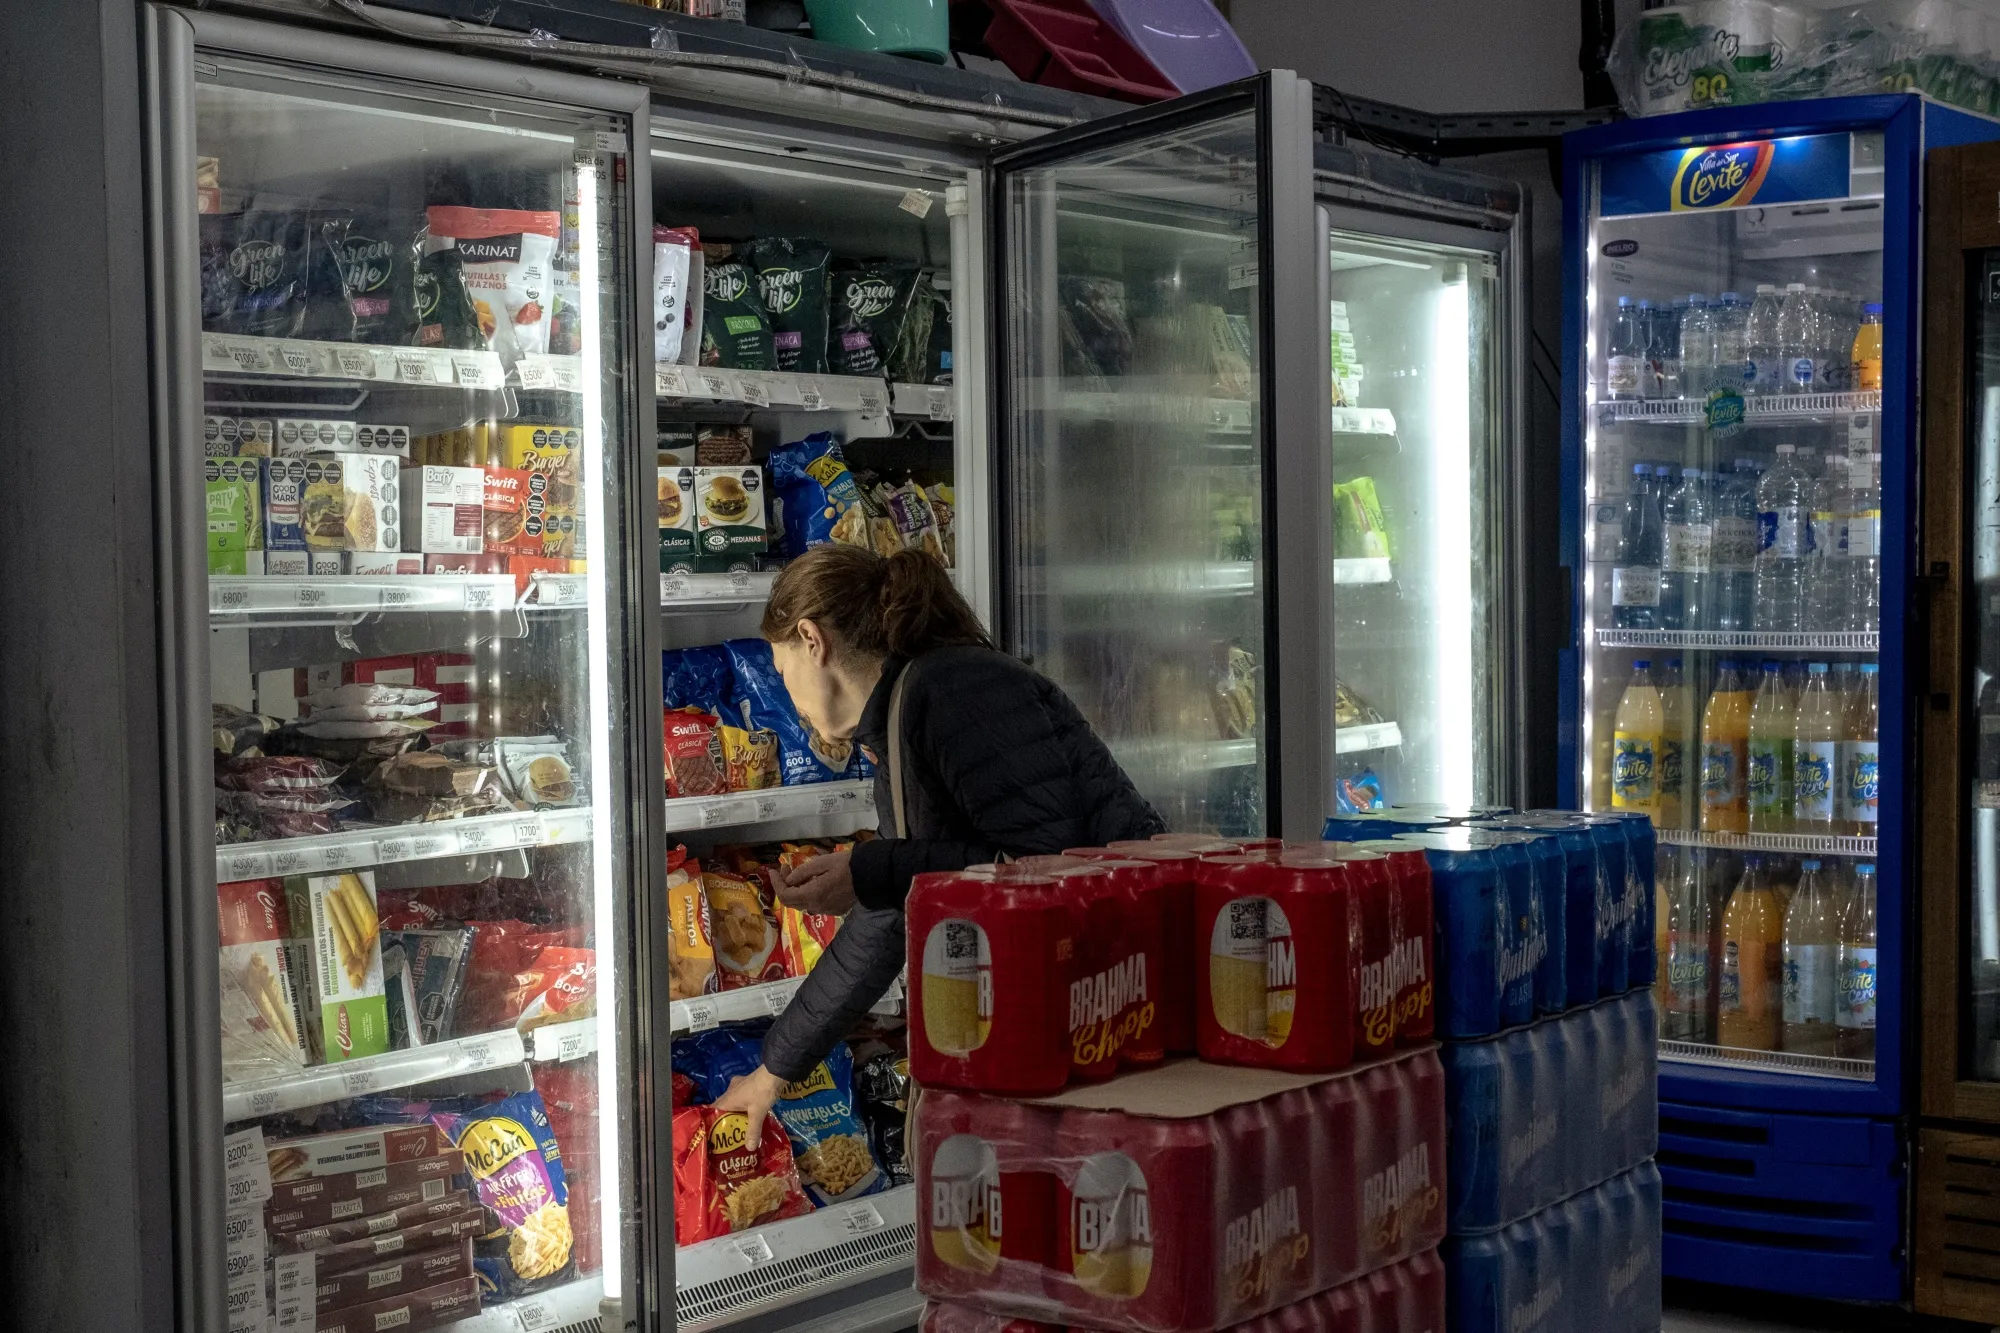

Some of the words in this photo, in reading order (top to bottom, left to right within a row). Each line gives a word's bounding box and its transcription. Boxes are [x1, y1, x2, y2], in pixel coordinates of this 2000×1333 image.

[593, 154, 605, 167] de
[1723, 151, 1740, 165] Sur
[457, 243, 518, 259] KARINAT
[234, 352, 254, 364] 4100
[288, 356, 305, 368] 6000
[343, 359, 361, 371] 8500
[205, 442, 230, 452] GOOD
[518, 449, 572, 478] Burger
[426, 468, 454, 486] Barfy
[483, 474, 519, 491] Swift
[272, 484, 297, 494] GOOD
[209, 492, 233, 505] PATY
[272, 494, 297, 502] MARK
[663, 537, 690, 547] CLÁSICAS
[729, 535, 762, 545] MEDIANAS
[315, 561, 339, 571] GOOD
[223, 592, 242, 604] 6800
[301, 590, 319, 601] 5500
[469, 590, 486, 602] 2900
[671, 723, 701, 737] Swift
[729, 745, 769, 769] Burger
[786, 756, 804, 767] 600
[805, 756, 812, 766] g
[464, 830, 482, 843] 5400
[520, 825, 537, 837] 1700
[326, 847, 344, 859] 4500
[382, 842, 400, 854] 4800
[277, 852, 296, 864] 4300
[315, 890, 325, 939] PRIMAVERA
[682, 895, 698, 947] PALITOS
[274, 946, 286, 972] CARNE
[319, 940, 332, 996] ARROLLADITOS
[1359, 935, 1427, 1013] BRAHMA
[328, 957, 340, 995] VERDURA
[1068, 951, 1148, 1034] BRAHMA
[292, 1002, 306, 1050] PRIMAVERA
[1072, 1001, 1156, 1065] Chopp
[561, 1040, 578, 1053] 7200
[349, 1073, 369, 1085] 5300
[253, 1092, 273, 1106] 5300
[227, 1145, 248, 1162] 8200
[464, 1135, 526, 1172] McCain
[357, 1169, 387, 1187] SIBARITA
[229, 1181, 251, 1198] 7300
[332, 1200, 362, 1216] SIBARITA
[226, 1219, 247, 1235] 6500
[370, 1216, 397, 1232] SIBARITA
[451, 1221, 461, 1236] XL
[227, 1255, 249, 1272] 6900
[431, 1256, 450, 1269] 940g
[369, 1268, 401, 1286] SIBARITA
[228, 1291, 249, 1307] 9000
[439, 1296, 458, 1309] 940g
[376, 1309, 410, 1327] SIBARITA
[523, 1308, 542, 1320] 6800
